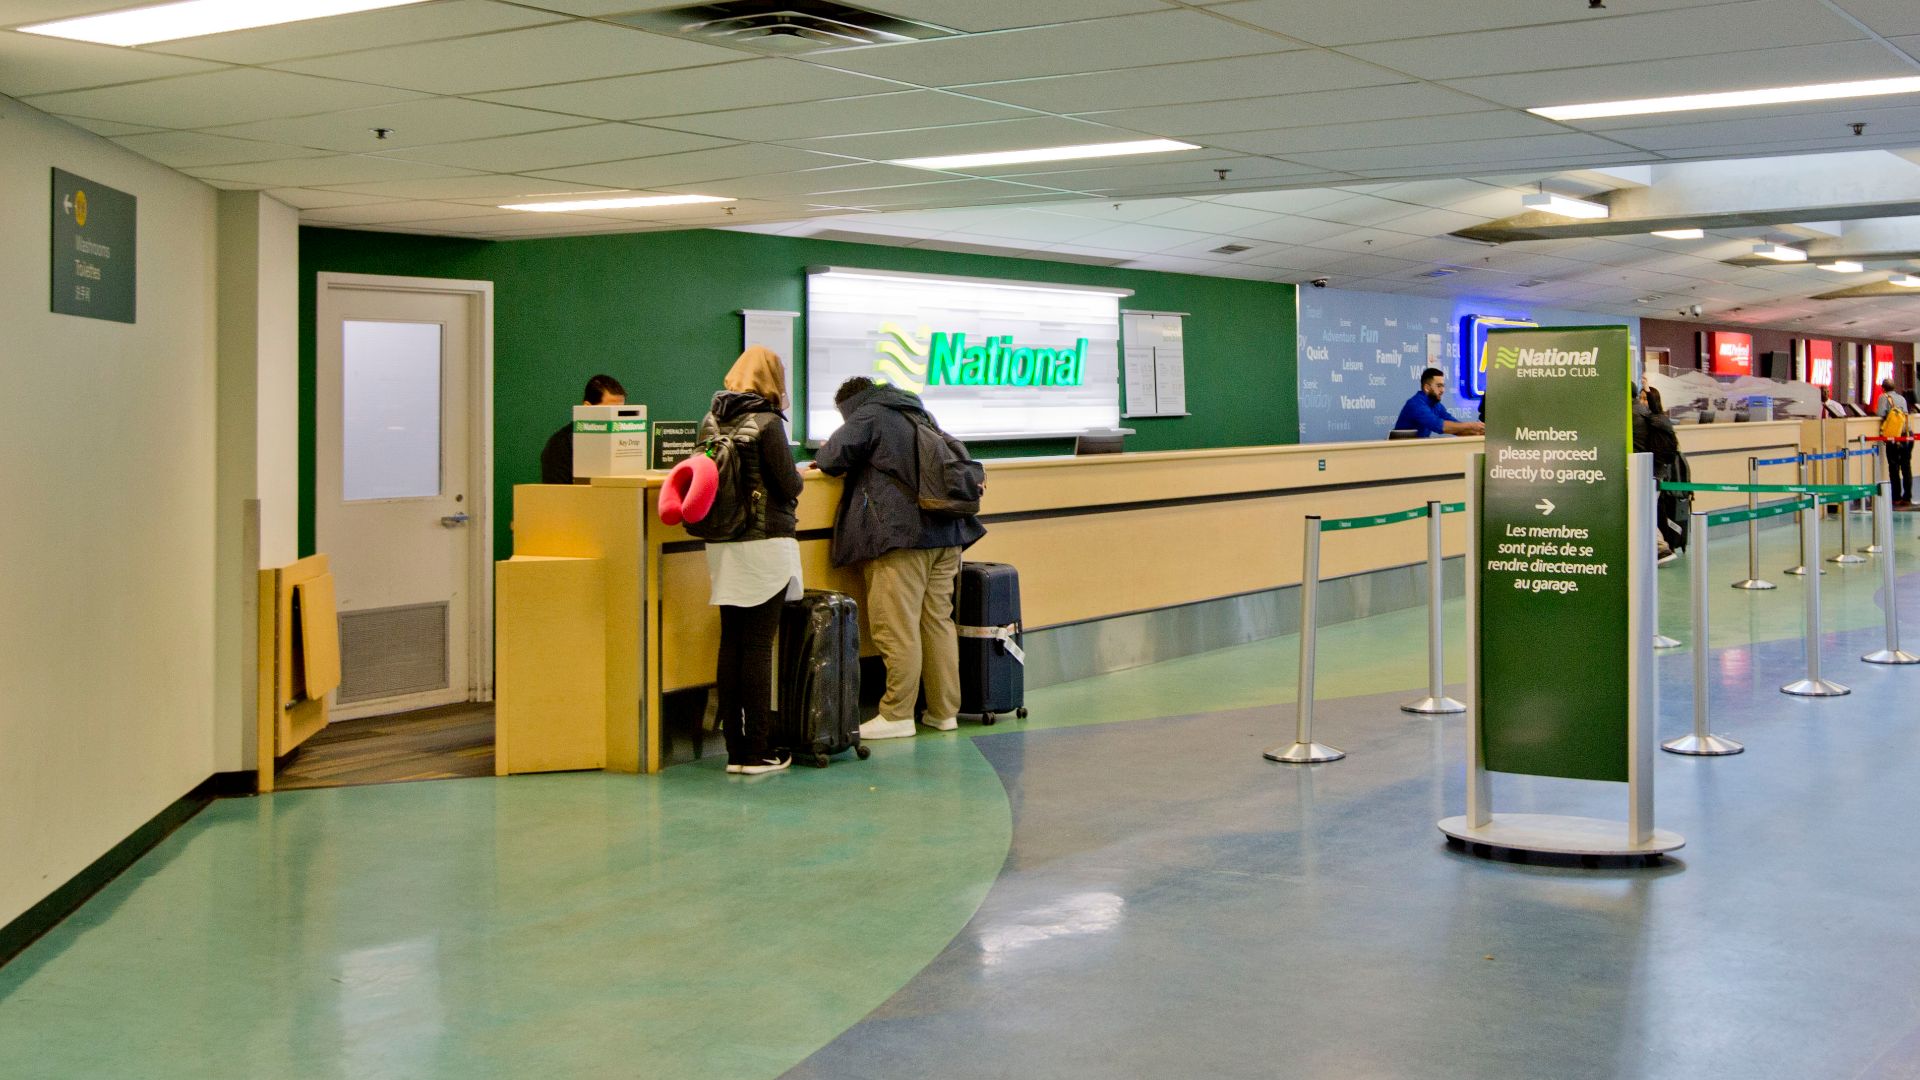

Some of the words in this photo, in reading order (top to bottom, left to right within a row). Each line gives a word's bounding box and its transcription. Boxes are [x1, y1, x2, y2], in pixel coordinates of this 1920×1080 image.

[1360, 325, 1379, 343] Fun
[1306, 345, 1329, 361] Quick
[1403, 341, 1419, 353] Travel
[926, 332, 1089, 386] National
[1342, 358, 1364, 371] Leisure
[1376, 348, 1402, 368] Family
[1517, 347, 1599, 366] National
[1331, 370, 1343, 383] fun
[1517, 368, 1567, 378] EMERALD
[1811, 358, 1832, 385] AVIS
[1340, 395, 1376, 410] Vacation
[620, 422, 646, 431] National
[1515, 426, 1578, 441] Members
[1499, 446, 1541, 461] please
[1543, 446, 1598, 463] proceed
[1490, 465, 1538, 483] directly
[1540, 467, 1555, 480] to
[1556, 468, 1607, 484] garage.
[1506, 524, 1527, 537] Les
[1528, 525, 1589, 539] membres
[1498, 542, 1526, 554] sont
[1527, 541, 1558, 558] priés
[1560, 542, 1577, 556] de
[1578, 546, 1594, 557] se
[1488, 558, 1529, 572] rendre
[1530, 558, 1608, 575] directement
[1513, 579, 1530, 589] au
[1532, 580, 1579, 594] garage.
